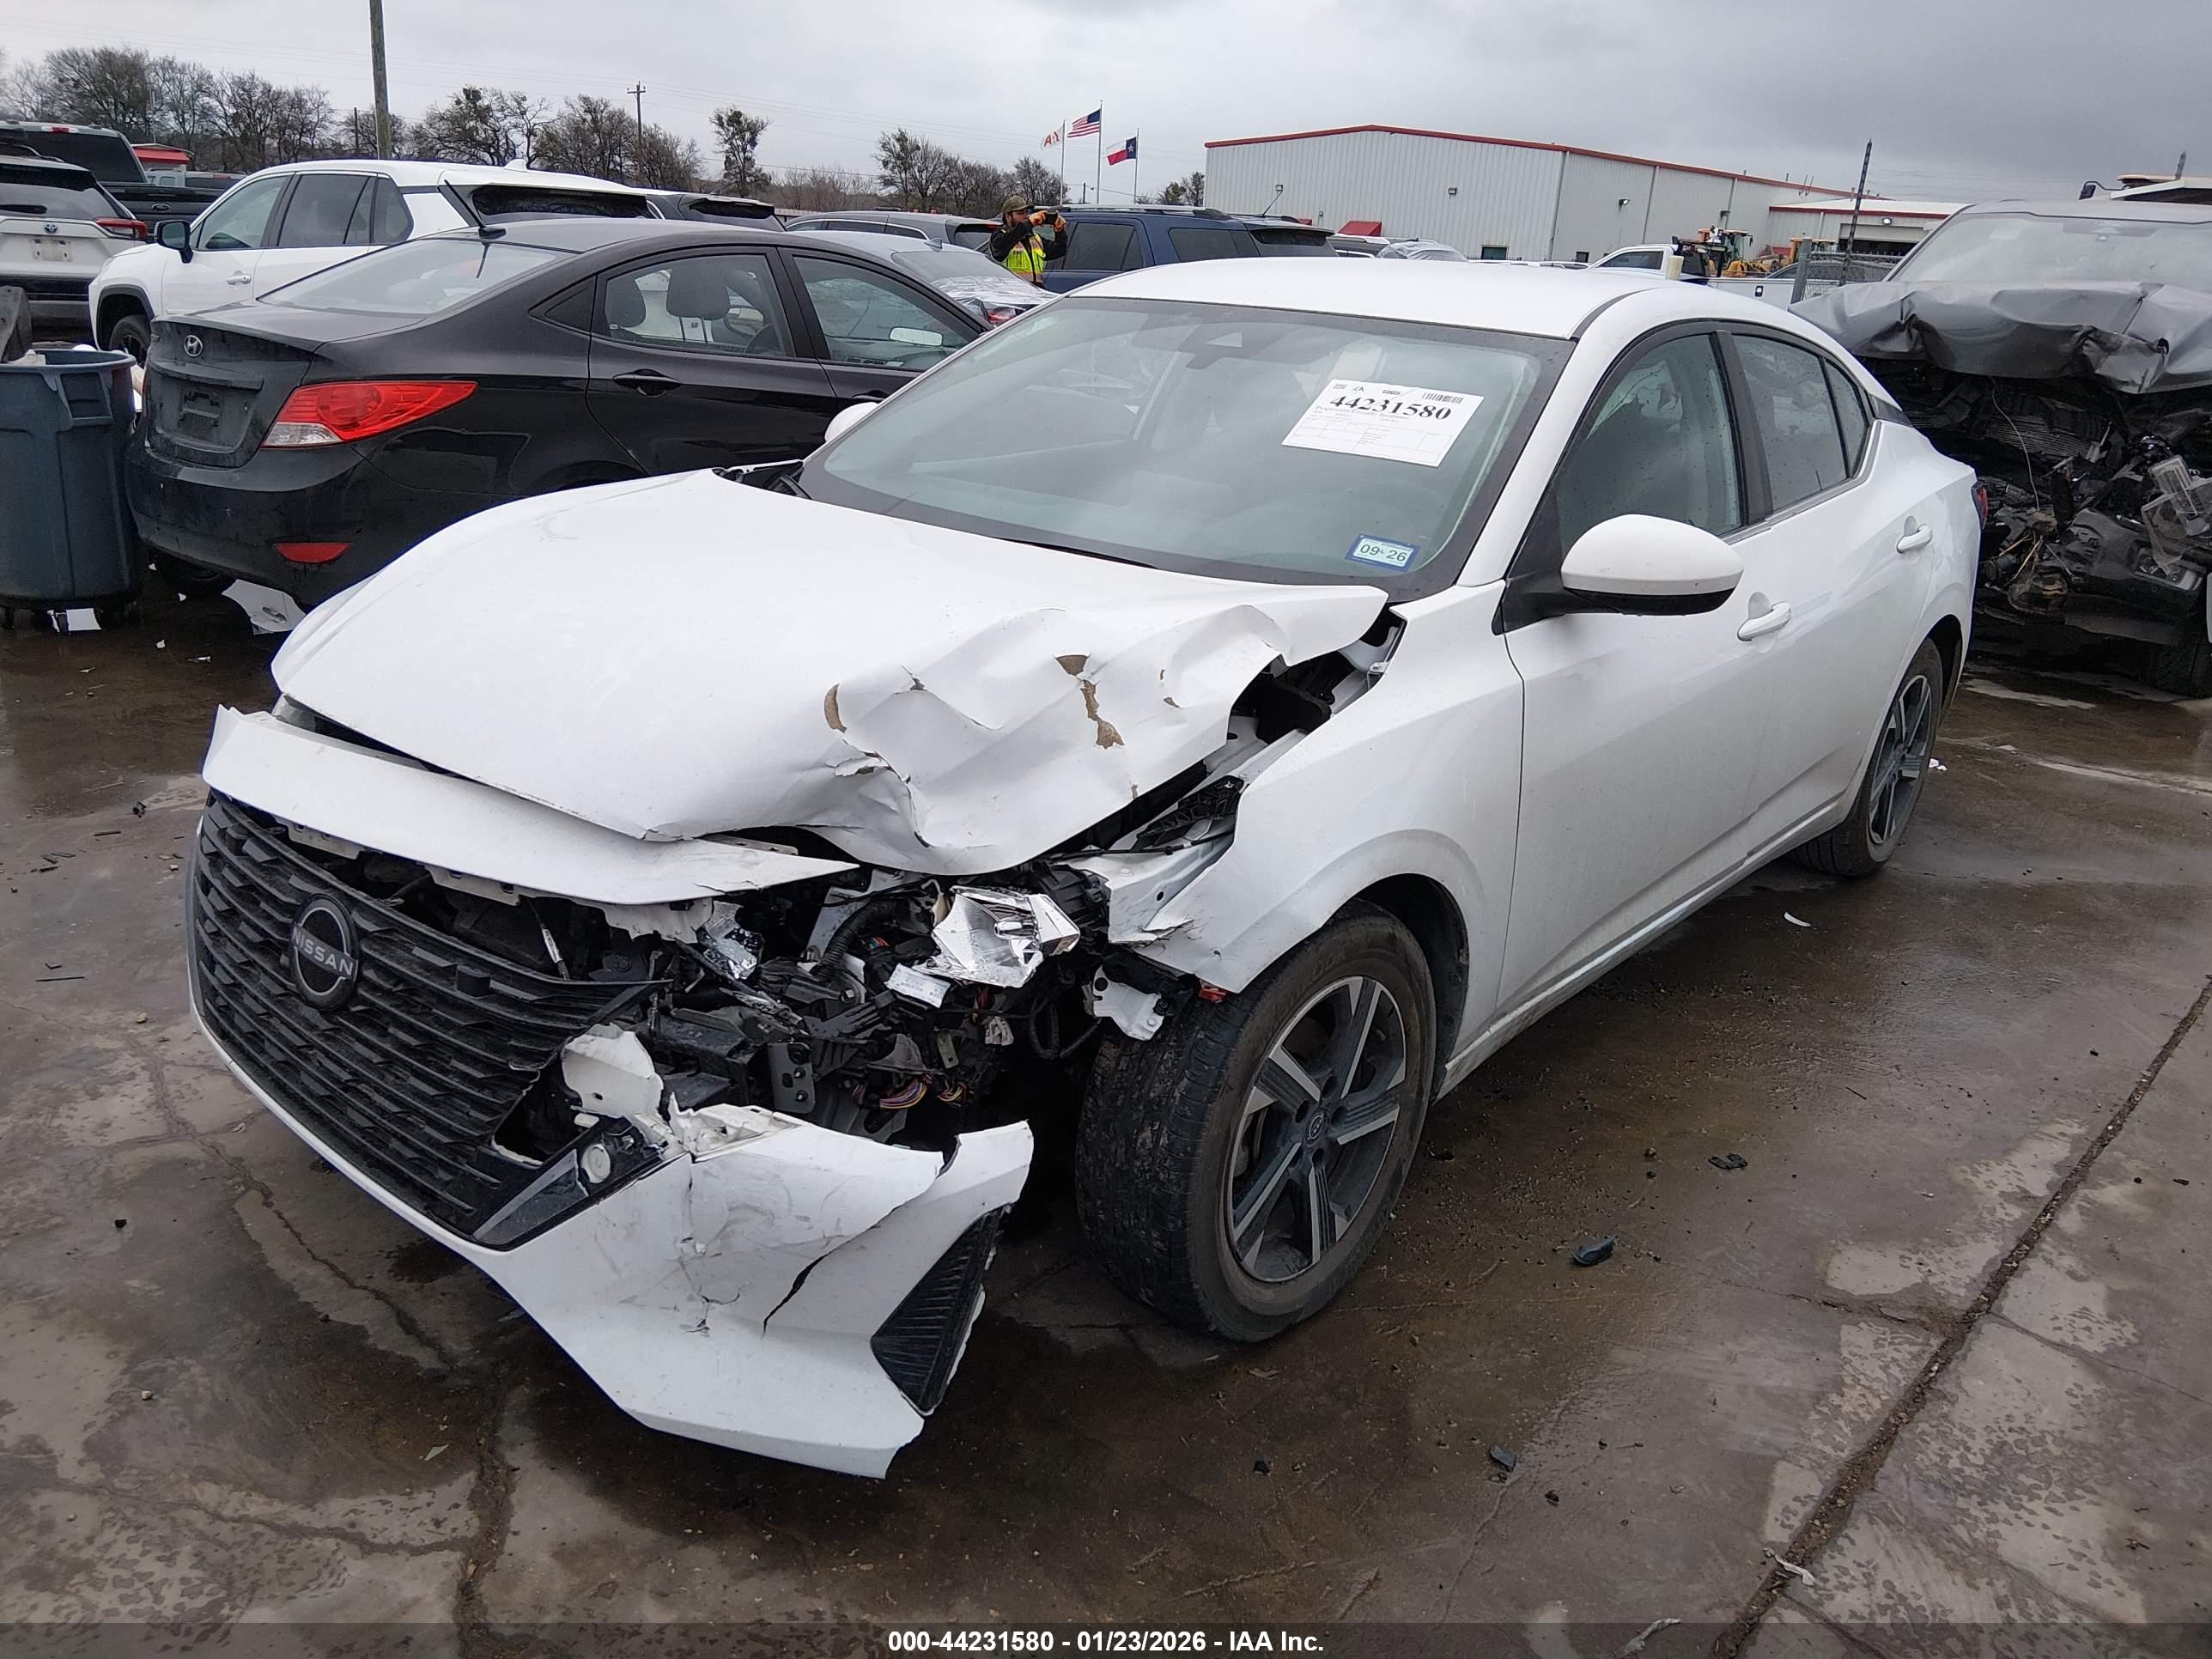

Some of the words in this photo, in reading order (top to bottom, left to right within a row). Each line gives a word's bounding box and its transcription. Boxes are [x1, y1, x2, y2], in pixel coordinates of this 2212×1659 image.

[1329, 395, 1451, 421] 44231580
[1360, 544, 1380, 556] 09
[1386, 550, 1408, 562] 26
[292, 927, 354, 975] NISSAN
